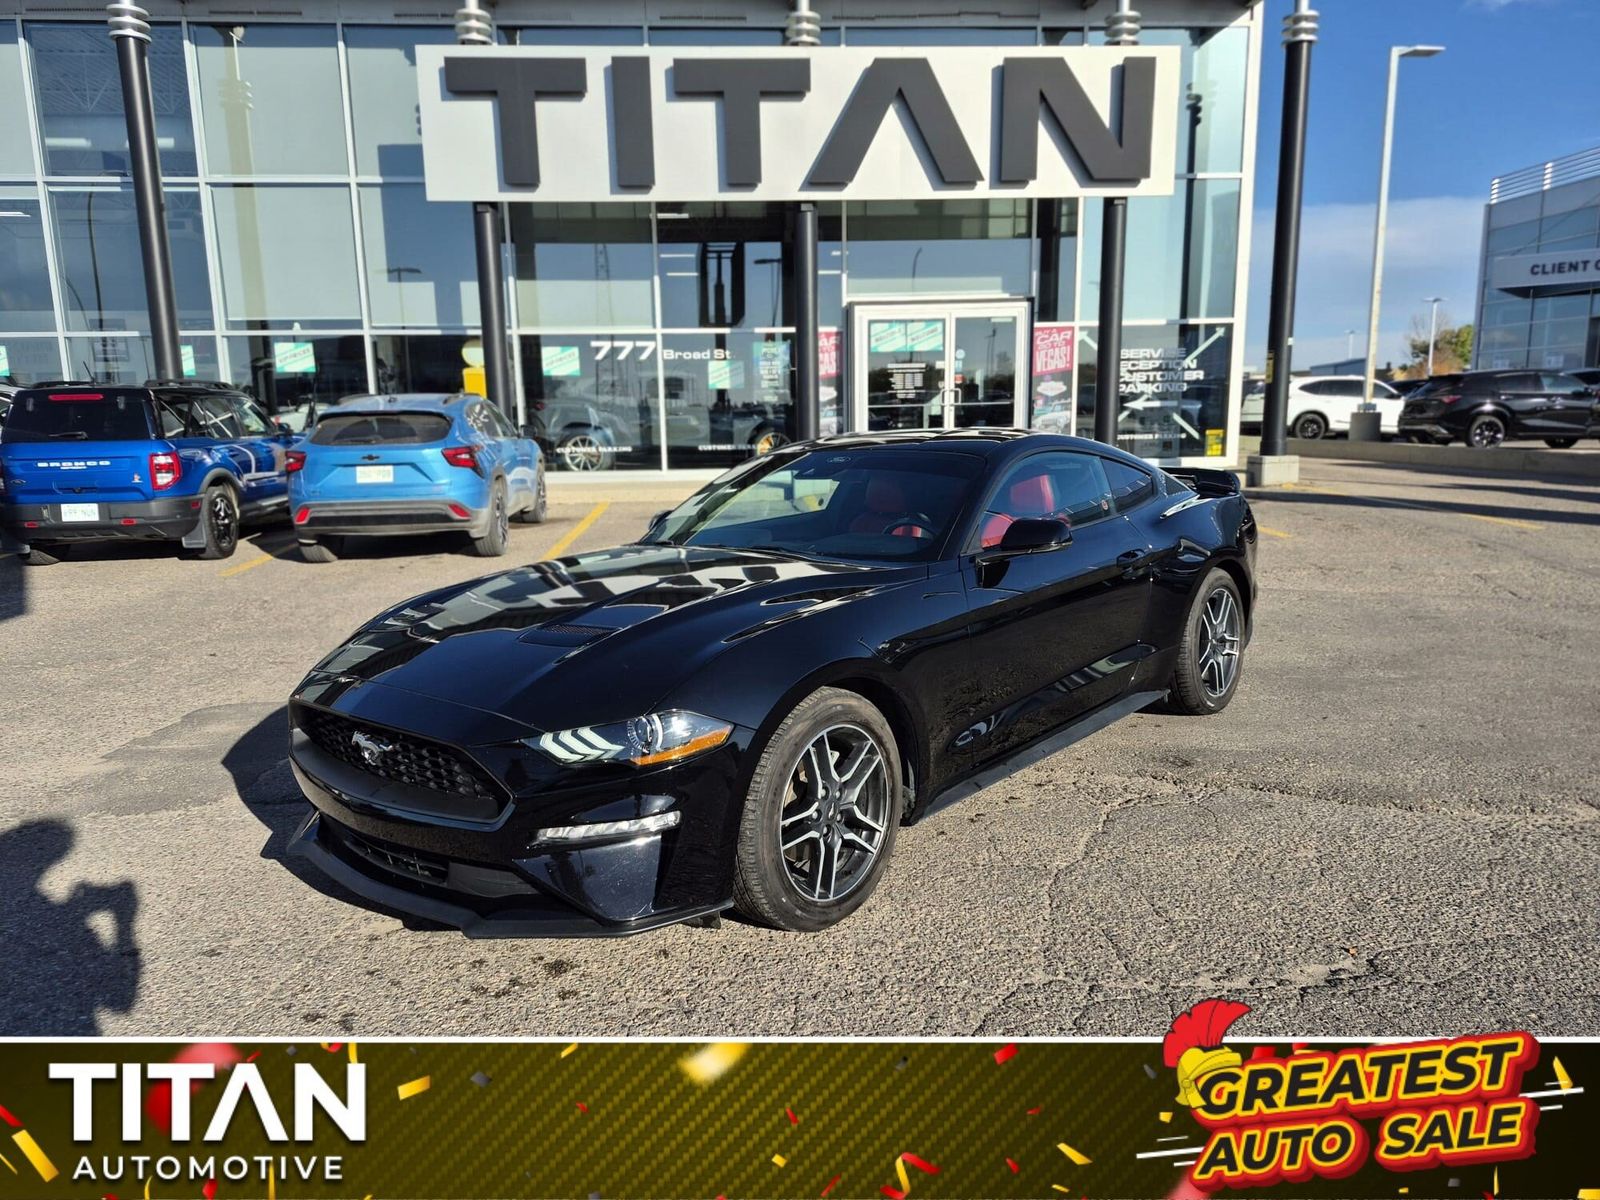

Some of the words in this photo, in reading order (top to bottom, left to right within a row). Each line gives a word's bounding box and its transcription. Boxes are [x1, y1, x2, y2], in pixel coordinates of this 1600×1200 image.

[443, 55, 1157, 187] TITAN
[1530, 260, 1590, 276] CLIENT
[1036, 330, 1072, 345] CAR
[590, 340, 657, 361] 777
[663, 349, 711, 360] Broad
[1035, 345, 1071, 373] VEGAS!
[1119, 359, 1198, 371] ECEPTION
